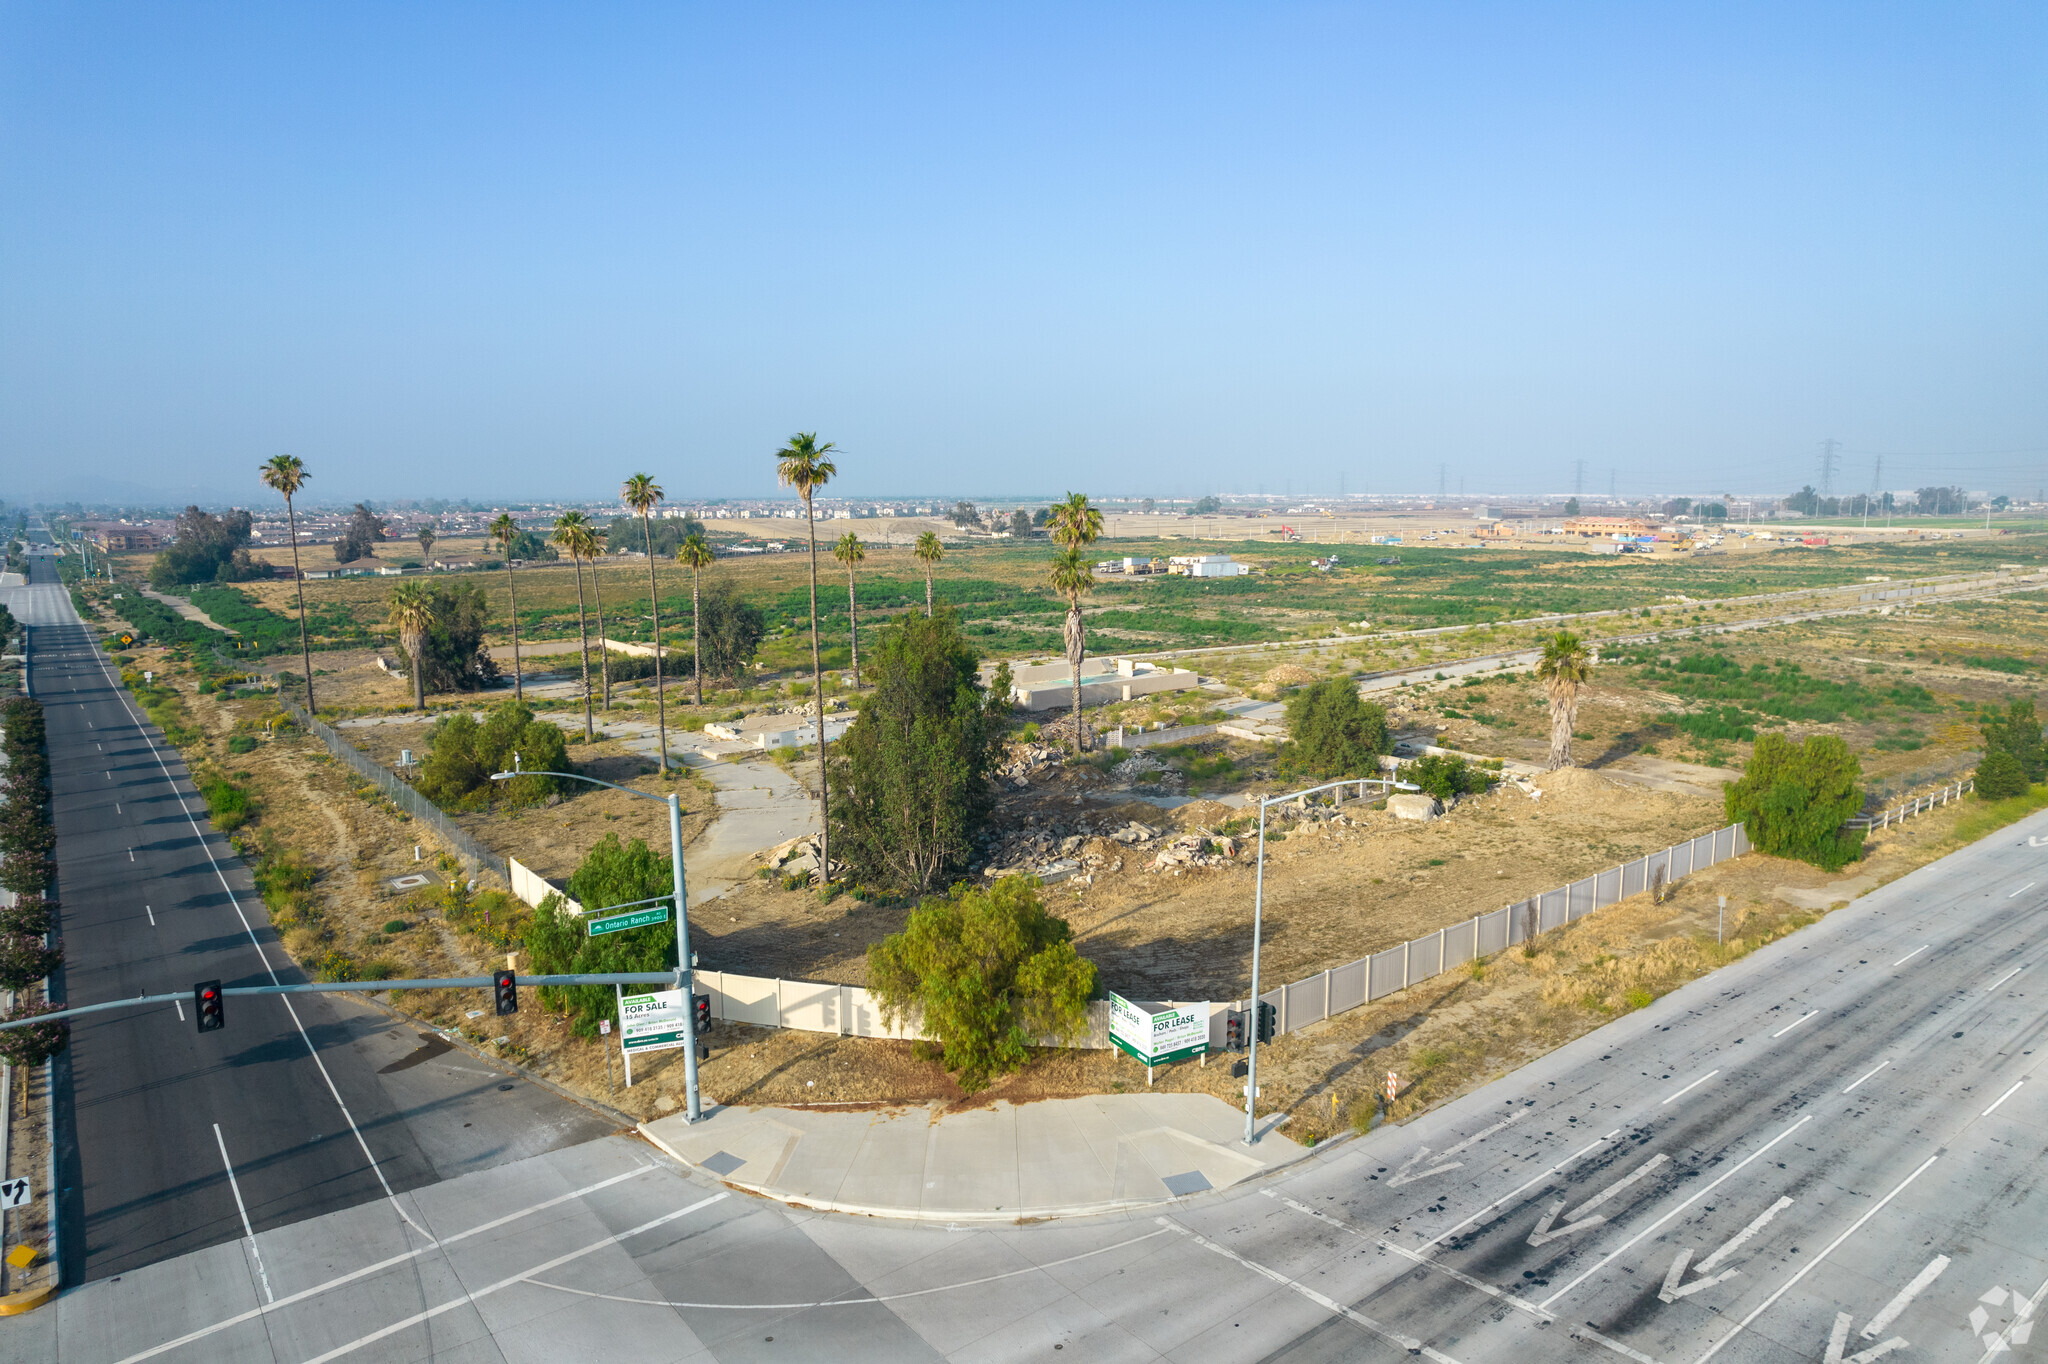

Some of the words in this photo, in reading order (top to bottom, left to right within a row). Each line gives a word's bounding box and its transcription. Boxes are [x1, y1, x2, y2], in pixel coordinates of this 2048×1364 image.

[606, 920, 628, 930] Ontario
[631, 915, 650, 924] Ranch
[625, 1005, 643, 1014] FOR
[646, 1002, 667, 1011] SALE
[1112, 1002, 1122, 1013] FOR
[1124, 1010, 1139, 1025] LEASE
[1154, 1013, 1175, 1022] AVAILABLE
[1154, 1021, 1169, 1032] FOR
[1172, 1015, 1194, 1027] LEASE
